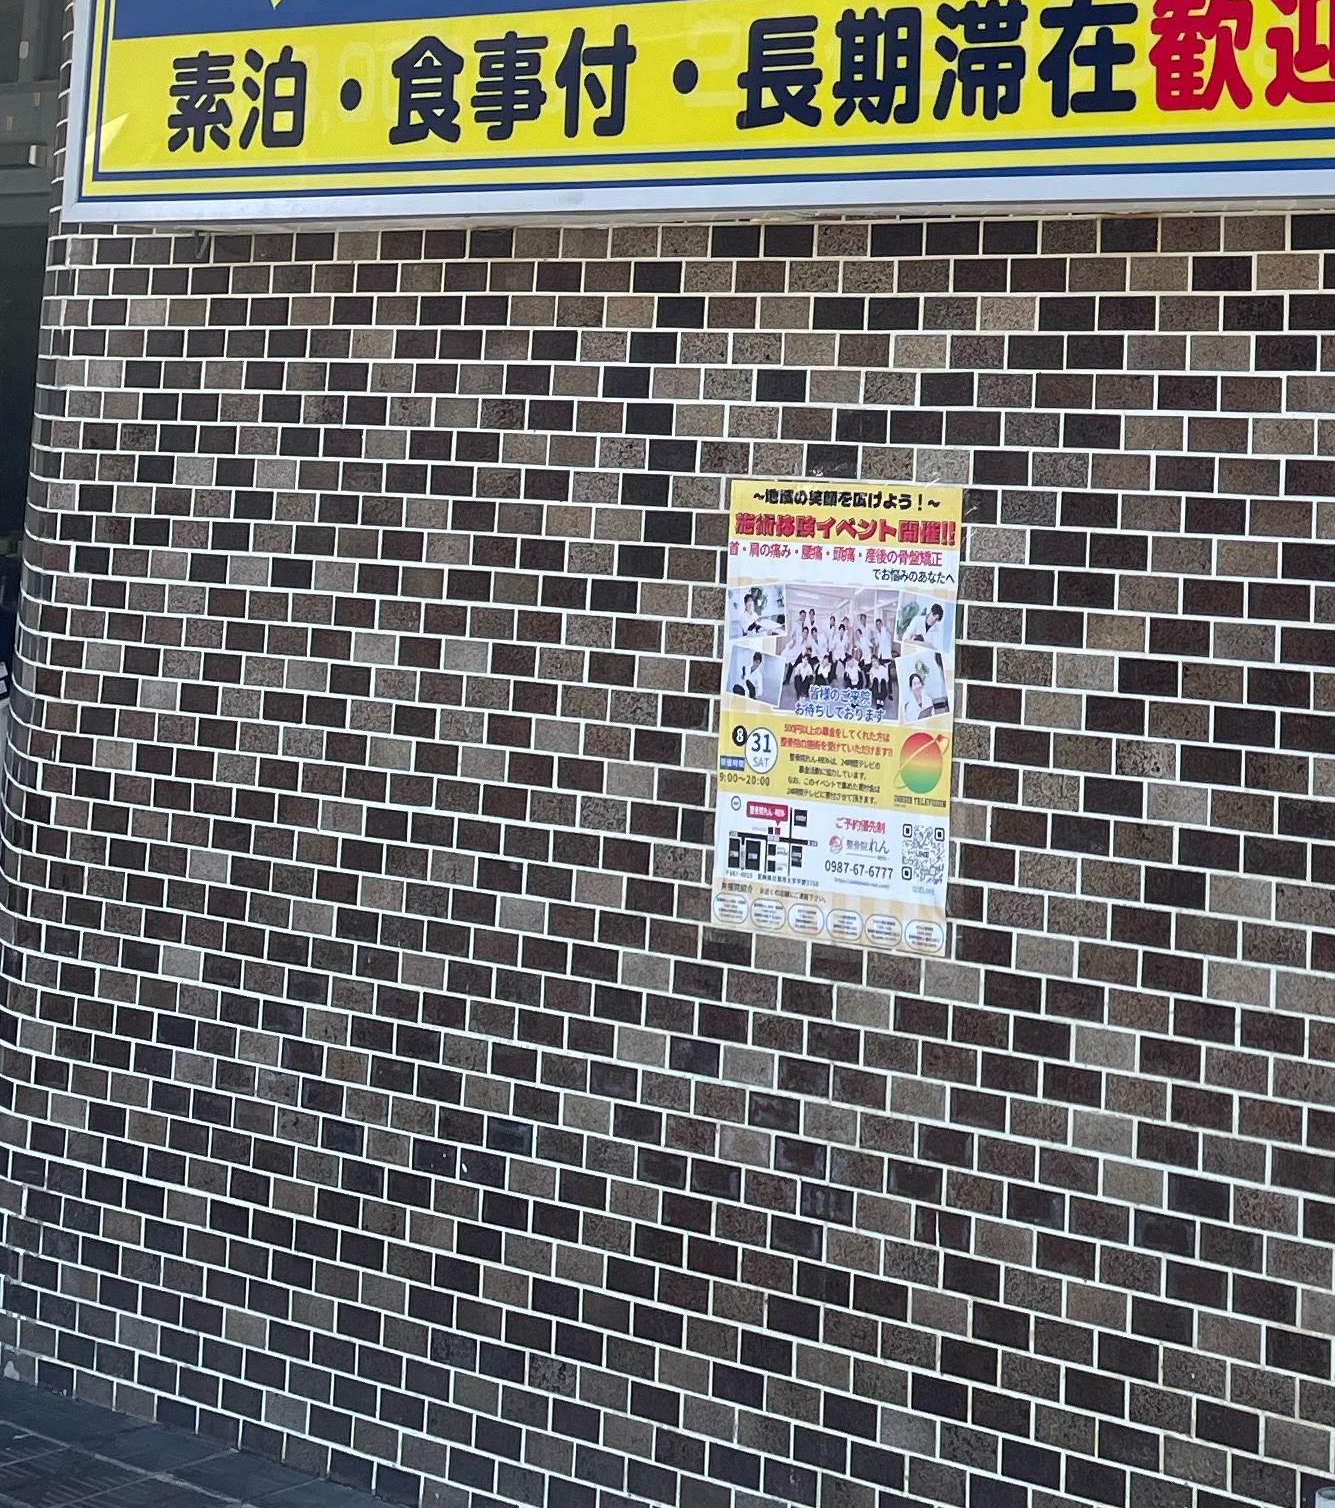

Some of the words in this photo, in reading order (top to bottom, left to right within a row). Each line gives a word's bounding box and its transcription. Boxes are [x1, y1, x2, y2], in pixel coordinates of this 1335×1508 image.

[872, 568, 955, 584] でお悩みのあなたへ
[795, 701, 885, 723] お待ちしております
[751, 732, 771, 753] 31
[753, 756, 770, 768] SAT
[825, 859, 893, 880] 0987-67-6777
